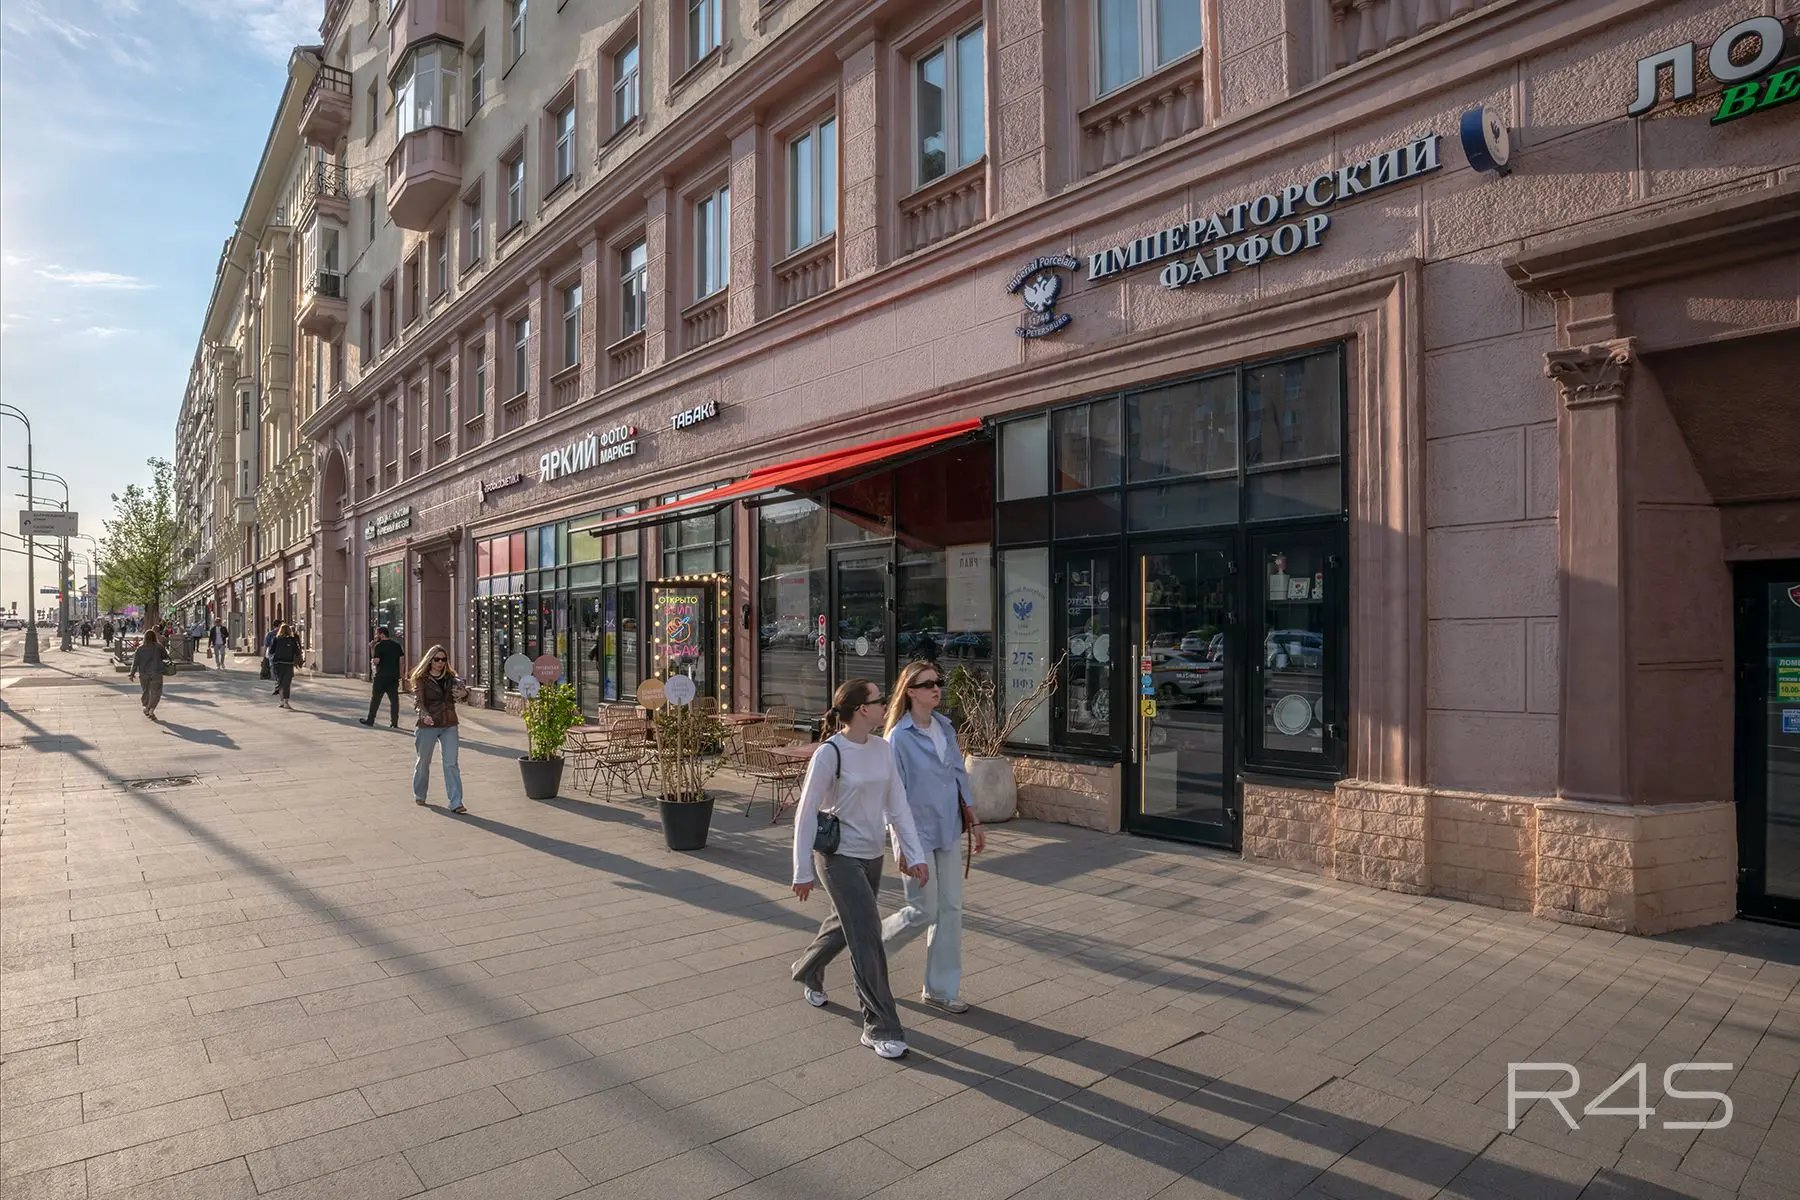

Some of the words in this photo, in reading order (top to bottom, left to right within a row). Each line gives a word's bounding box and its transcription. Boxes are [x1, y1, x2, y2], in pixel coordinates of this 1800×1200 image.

[1087, 133, 1442, 281] ИМПЕРАТОРСКИЙ
[1159, 213, 1331, 290] ФАРФОР
[1006, 259, 1038, 294] Imperial
[1039, 255, 1077, 270] Porcelain
[670, 402, 710, 430] ТАБАК
[600, 425, 628, 447] ФОТО
[539, 431, 599, 483] ЯРКИЙ
[600, 440, 636, 464] МАРКЕТ
[658, 596, 698, 604] ОТКРЫТО
[659, 645, 700, 656] ТАБАК
[1012, 651, 1034, 665] 275
